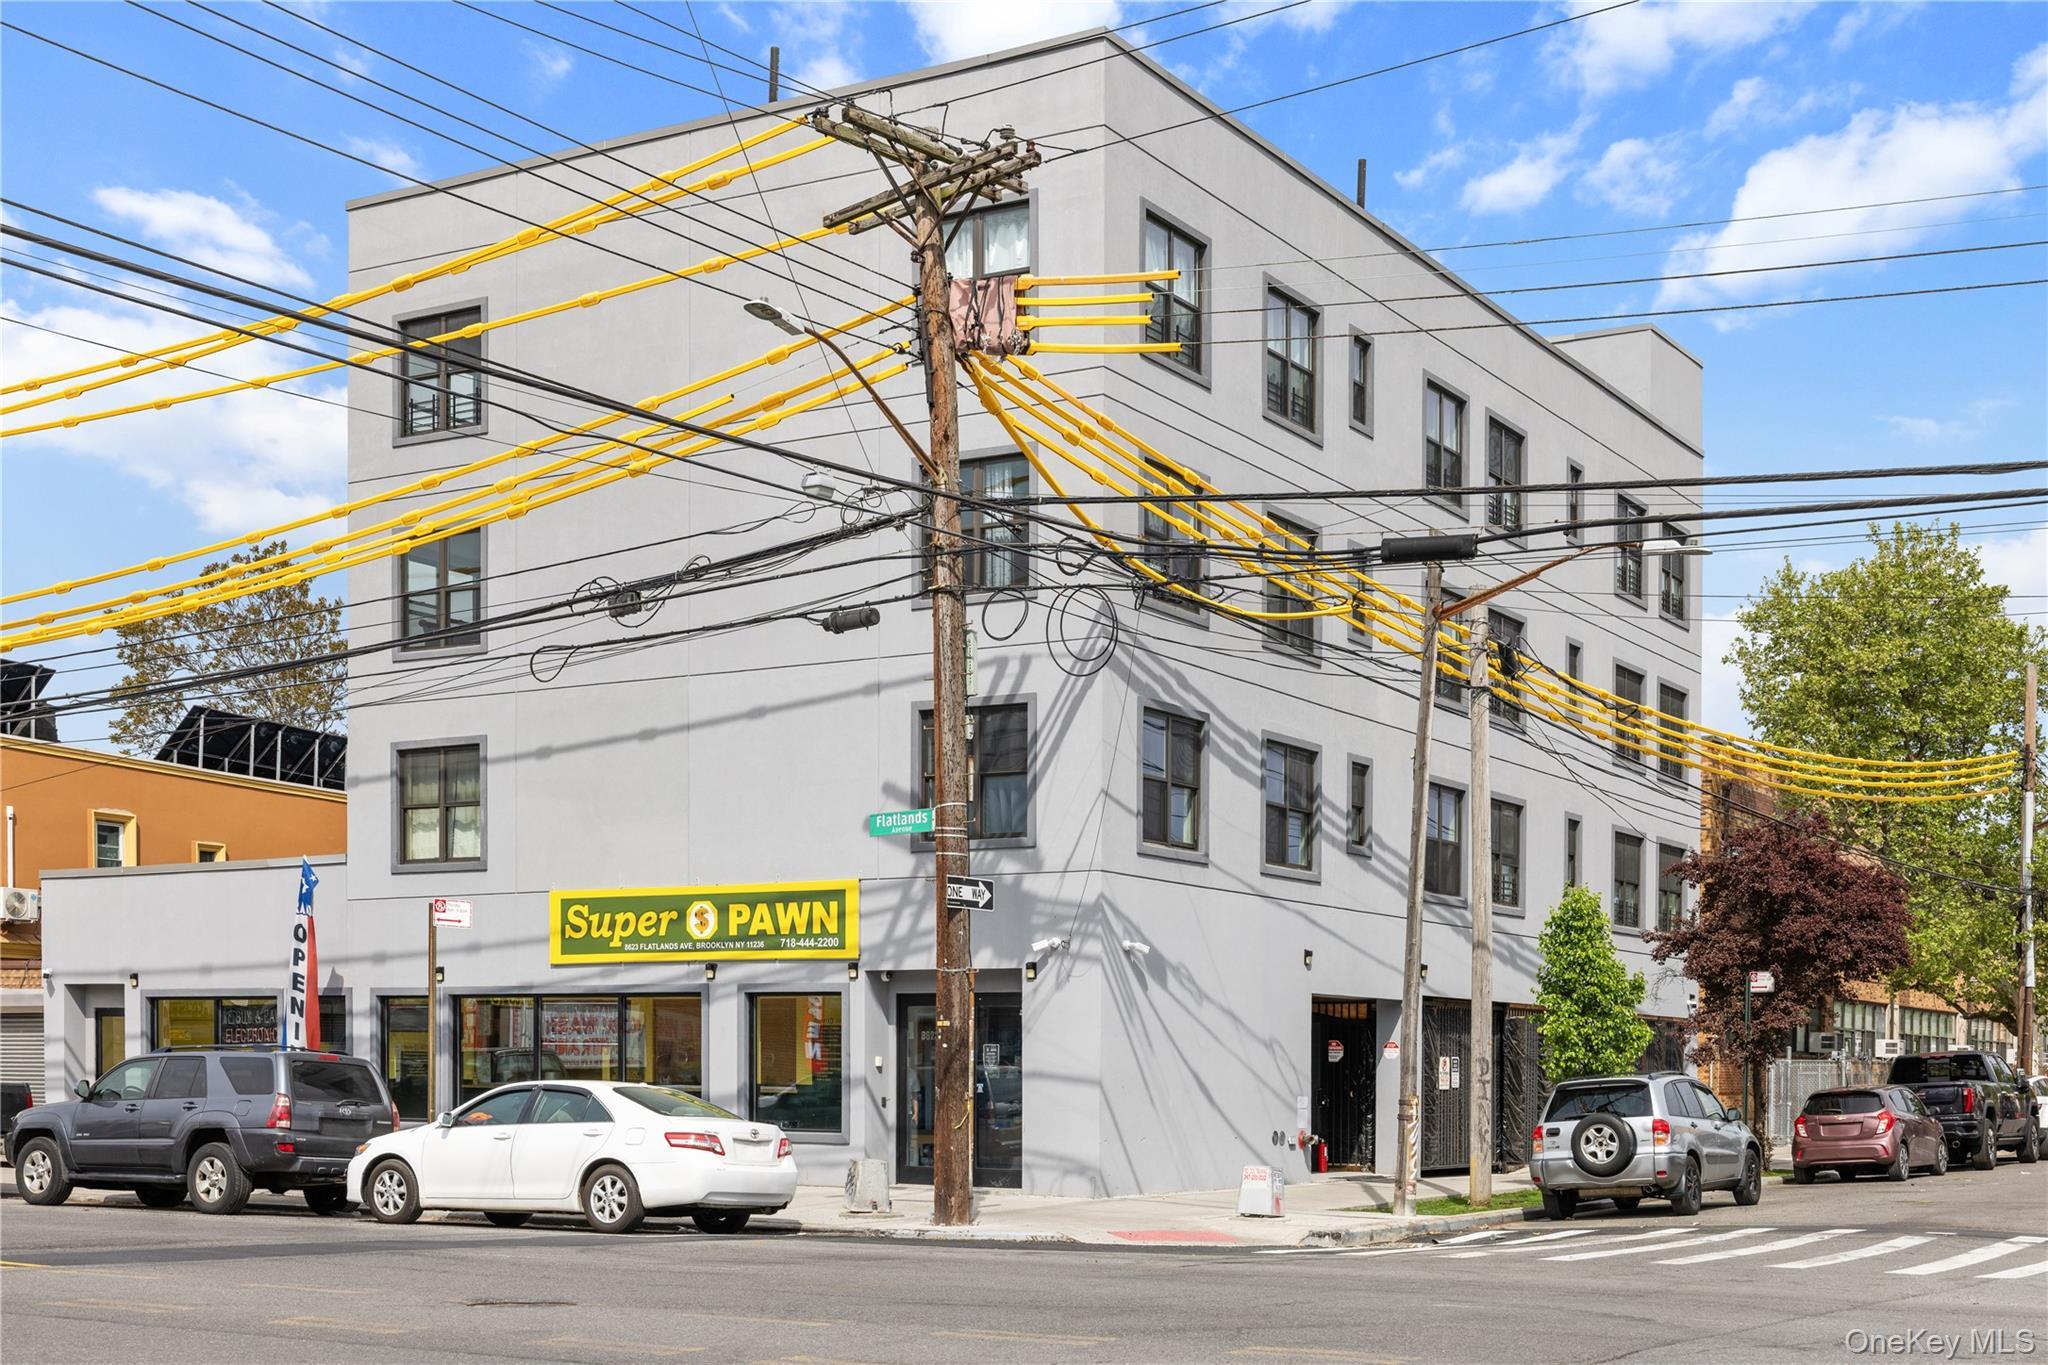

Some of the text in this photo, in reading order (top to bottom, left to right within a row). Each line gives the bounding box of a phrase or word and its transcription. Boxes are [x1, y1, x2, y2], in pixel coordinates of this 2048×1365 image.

[876, 811, 928, 827] Flatlands
[947, 885, 987, 900] ONE WAY
[565, 904, 678, 947] Super
[728, 901, 839, 936] PAWN
[624, 937, 839, 951] 8623 FLATLANDS AVE, BROOKLYN NY 11236 718-444-2200
[920, 1030, 937, 1041] 862
